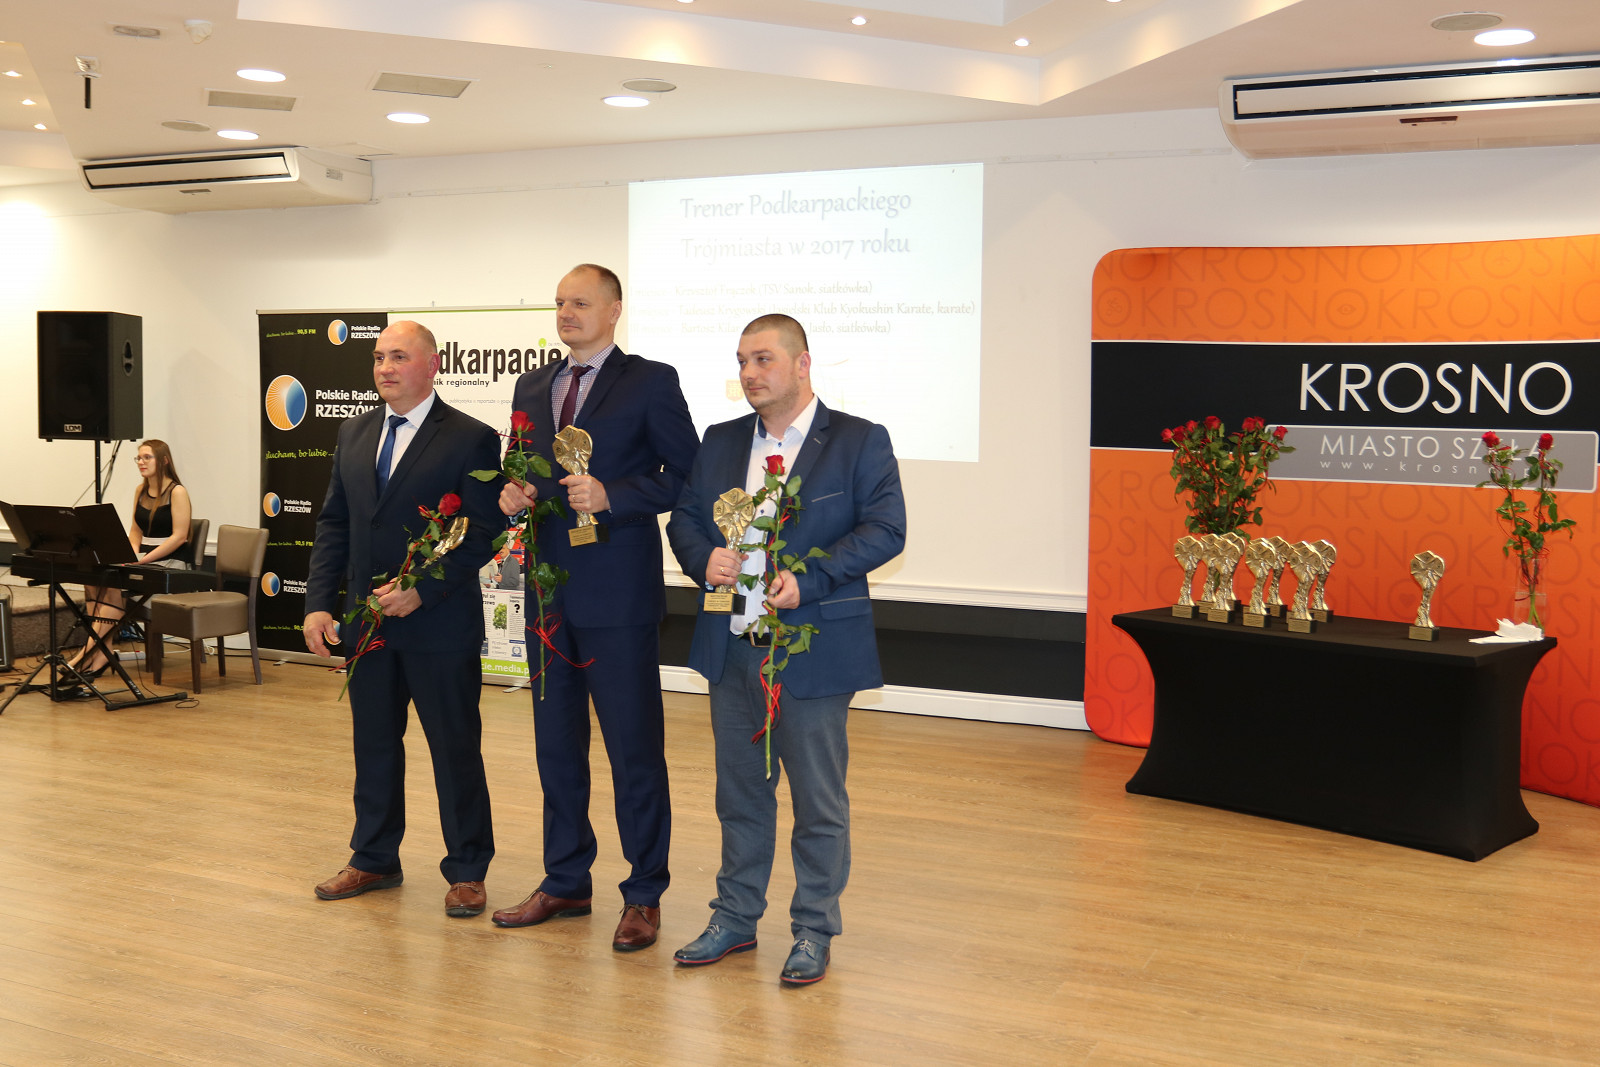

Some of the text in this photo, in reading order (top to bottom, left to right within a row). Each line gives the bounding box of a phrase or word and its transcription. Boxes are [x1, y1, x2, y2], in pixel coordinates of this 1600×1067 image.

[680, 187, 912, 220] Trener Podkarpackiego
[680, 228, 912, 265] Trójmiasta w 2017 roku
[819, 281, 873, 295] siatkówka)
[814, 302, 838, 315] Klub
[840, 302, 894, 318] Kyokushin
[896, 303, 935, 316] Karate,
[937, 301, 976, 316] karate)
[837, 320, 891, 334] siatkówka)
[439, 338, 562, 382] dkarpacie
[446, 378, 490, 388] regionalny
[1300, 362, 1573, 416] KROSNO
[315, 389, 379, 401] Polskie Radio
[1320, 434, 1545, 460] MIASTO SZŁA
[283, 585, 307, 594] RZESZÓ
